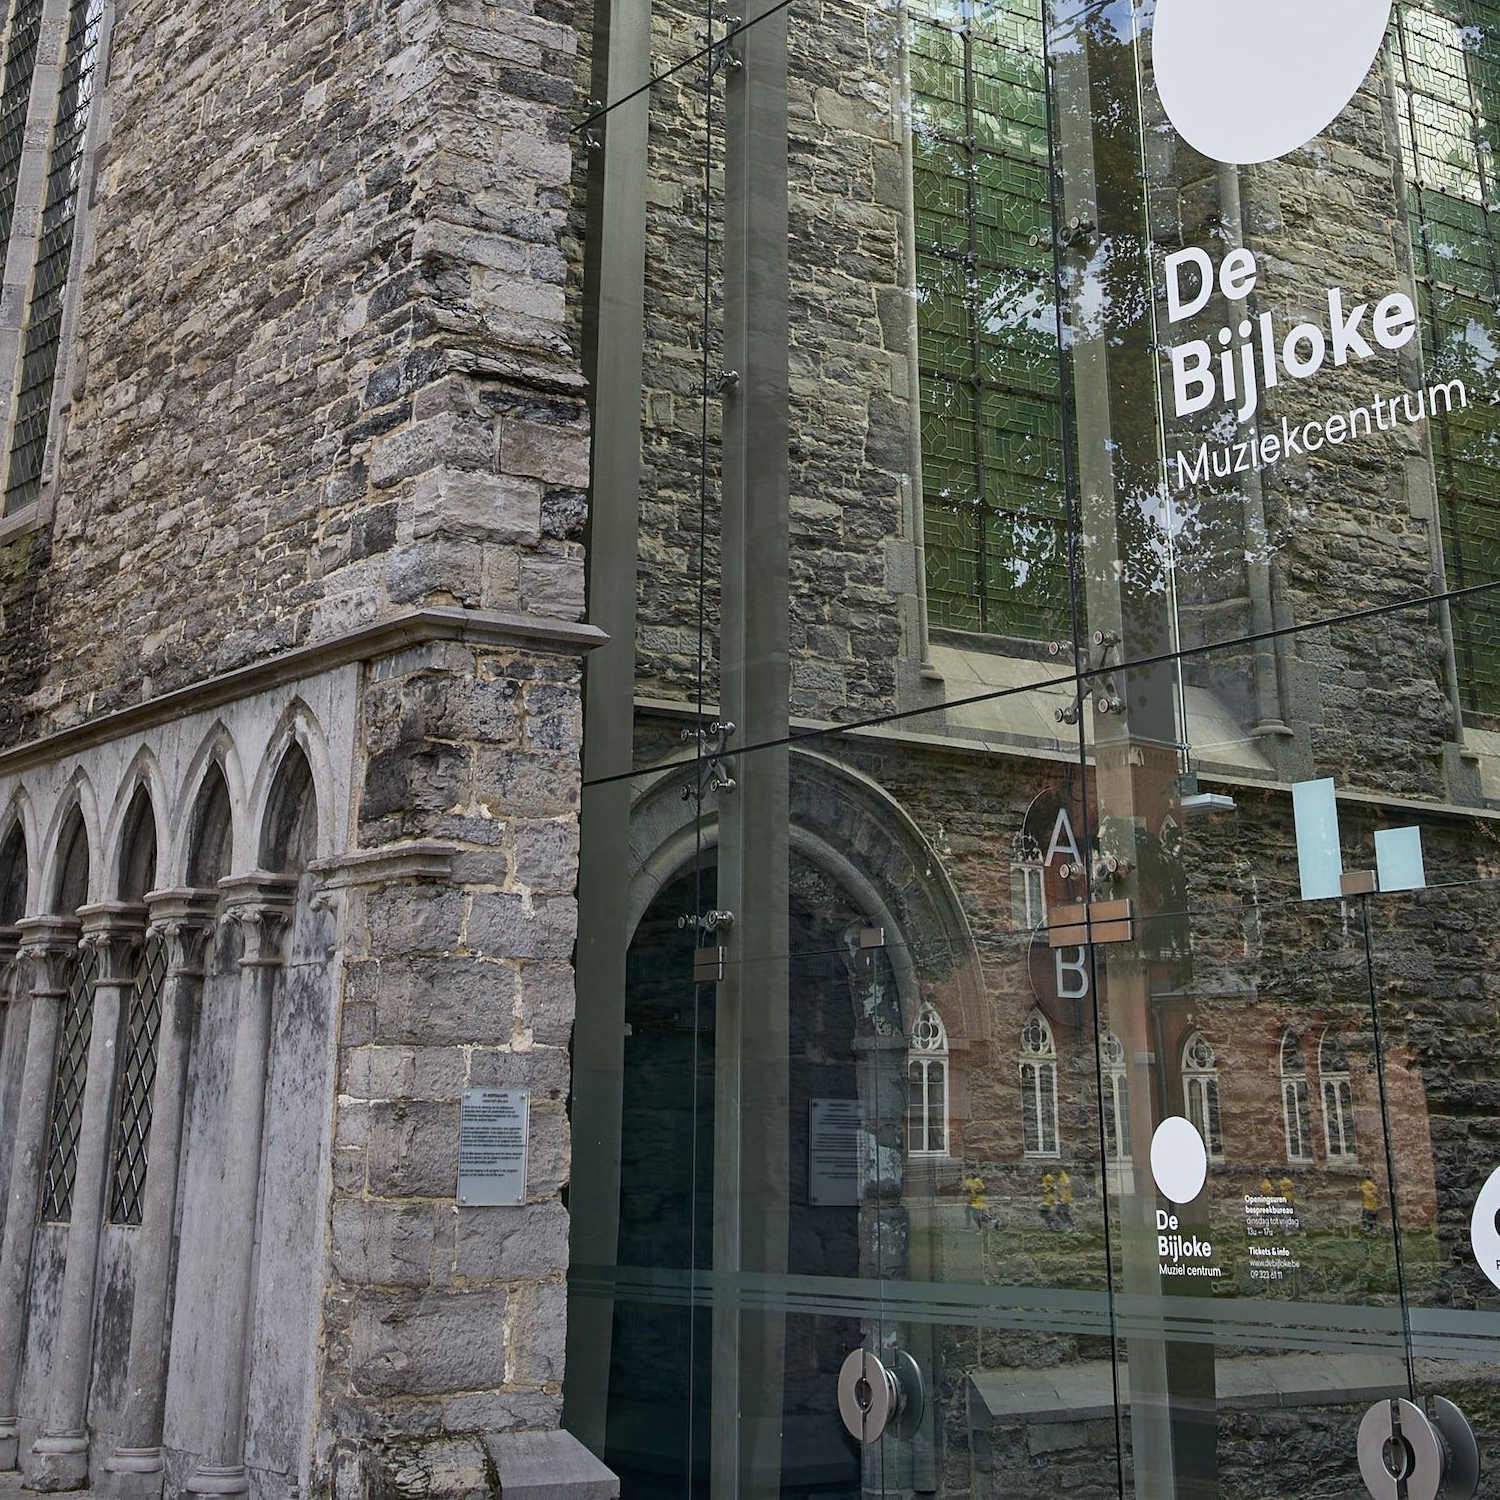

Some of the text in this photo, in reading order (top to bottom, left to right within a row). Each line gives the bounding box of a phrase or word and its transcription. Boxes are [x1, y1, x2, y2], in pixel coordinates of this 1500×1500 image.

[1164, 245, 1257, 324] De
[1171, 287, 1416, 423] Bijloke
[1176, 377, 1467, 489] Muziekcentrum
[1044, 807, 1083, 867] A
[1055, 945, 1089, 999] B
[1155, 1209, 1179, 1231] De
[1244, 1194, 1287, 1205] Openingsuren
[1270, 1218, 1279, 1226] tot
[1157, 1235, 1212, 1263] Bijloke
[1248, 1246, 1271, 1256] Tickets
[1277, 1247, 1290, 1257] info
